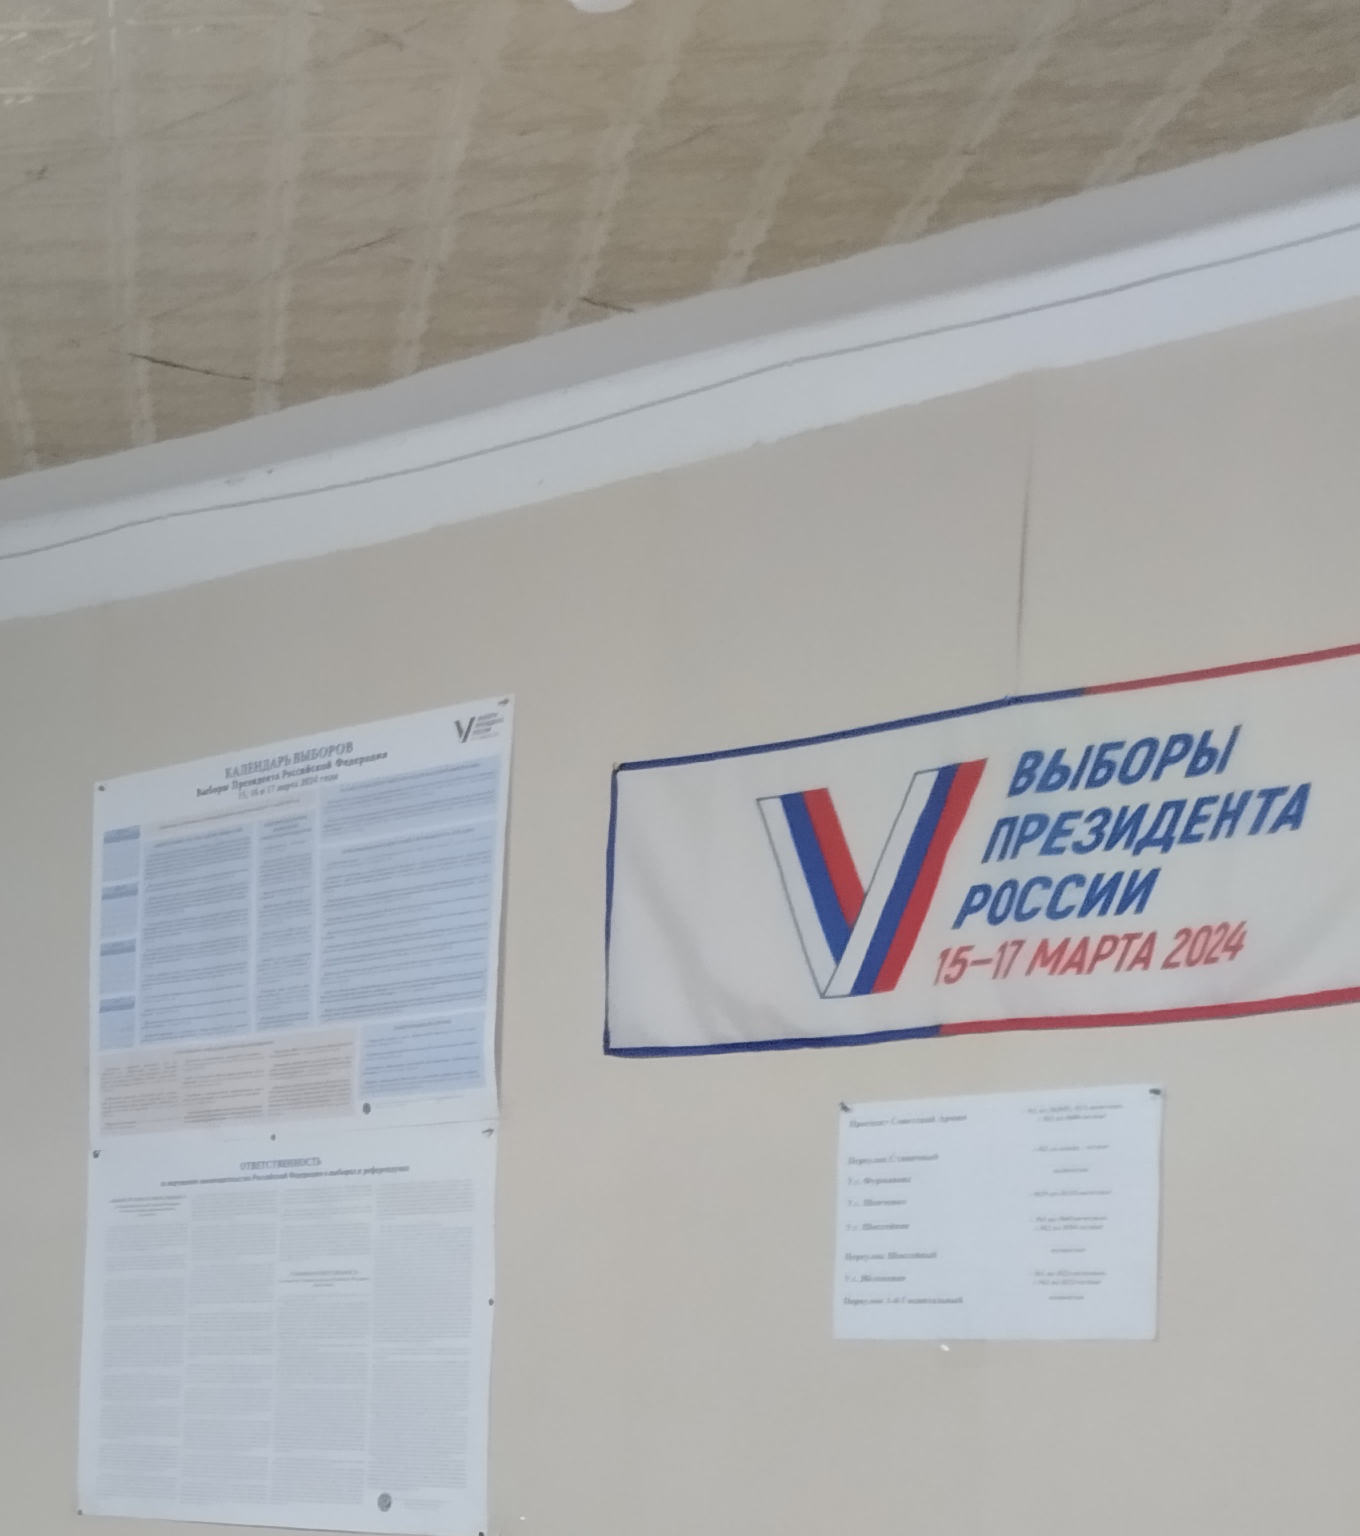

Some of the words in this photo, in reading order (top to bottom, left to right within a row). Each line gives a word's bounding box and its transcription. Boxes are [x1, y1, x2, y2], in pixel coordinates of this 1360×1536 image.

[1006, 724, 1242, 799] ВЫБОРЫ
[981, 781, 1312, 864] ПРЕЗИДЕНТА
[951, 867, 1161, 930] РОССИИ
[1024, 932, 1156, 979] МАРТА
[1160, 920, 1249, 971] 2024
